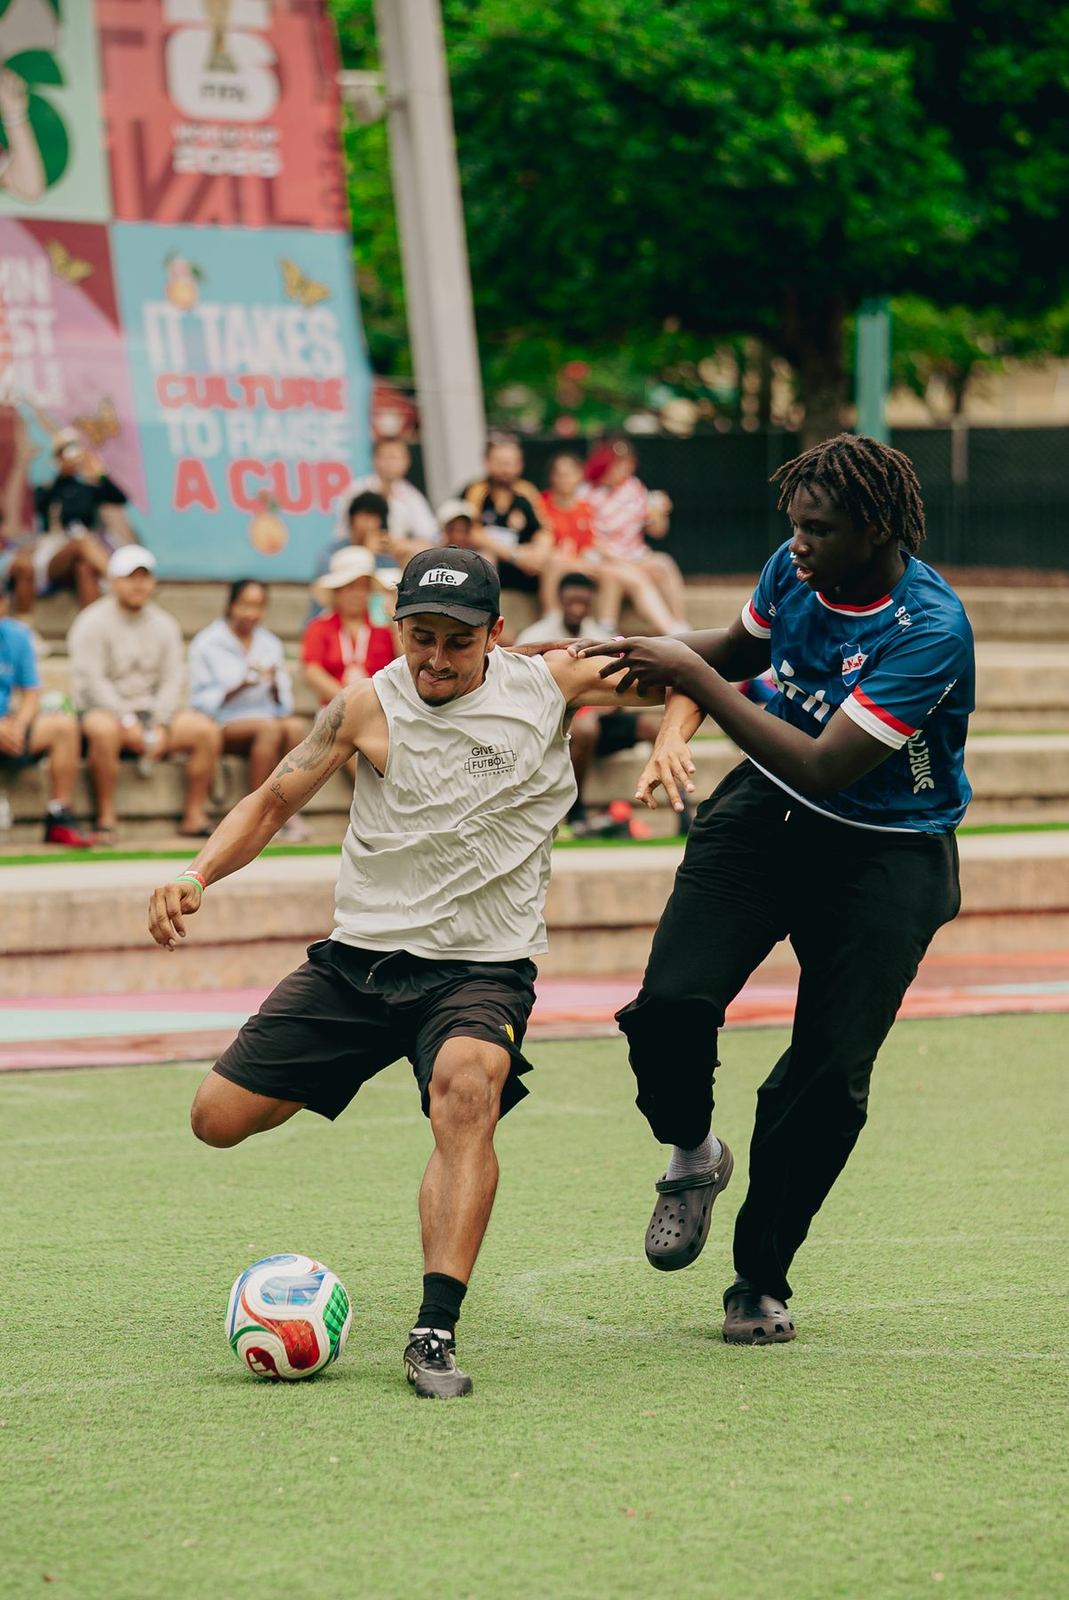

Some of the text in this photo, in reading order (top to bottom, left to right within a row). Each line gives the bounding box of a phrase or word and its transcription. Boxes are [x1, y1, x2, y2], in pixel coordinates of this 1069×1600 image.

[144, 302, 345, 376] IT TAKES
[156, 374, 345, 411] CULTURE
[162, 410, 352, 459] TO RAISE
[173, 457, 352, 515] A CUP
[428, 571, 457, 585] Life.
[471, 745, 494, 756] GIVE
